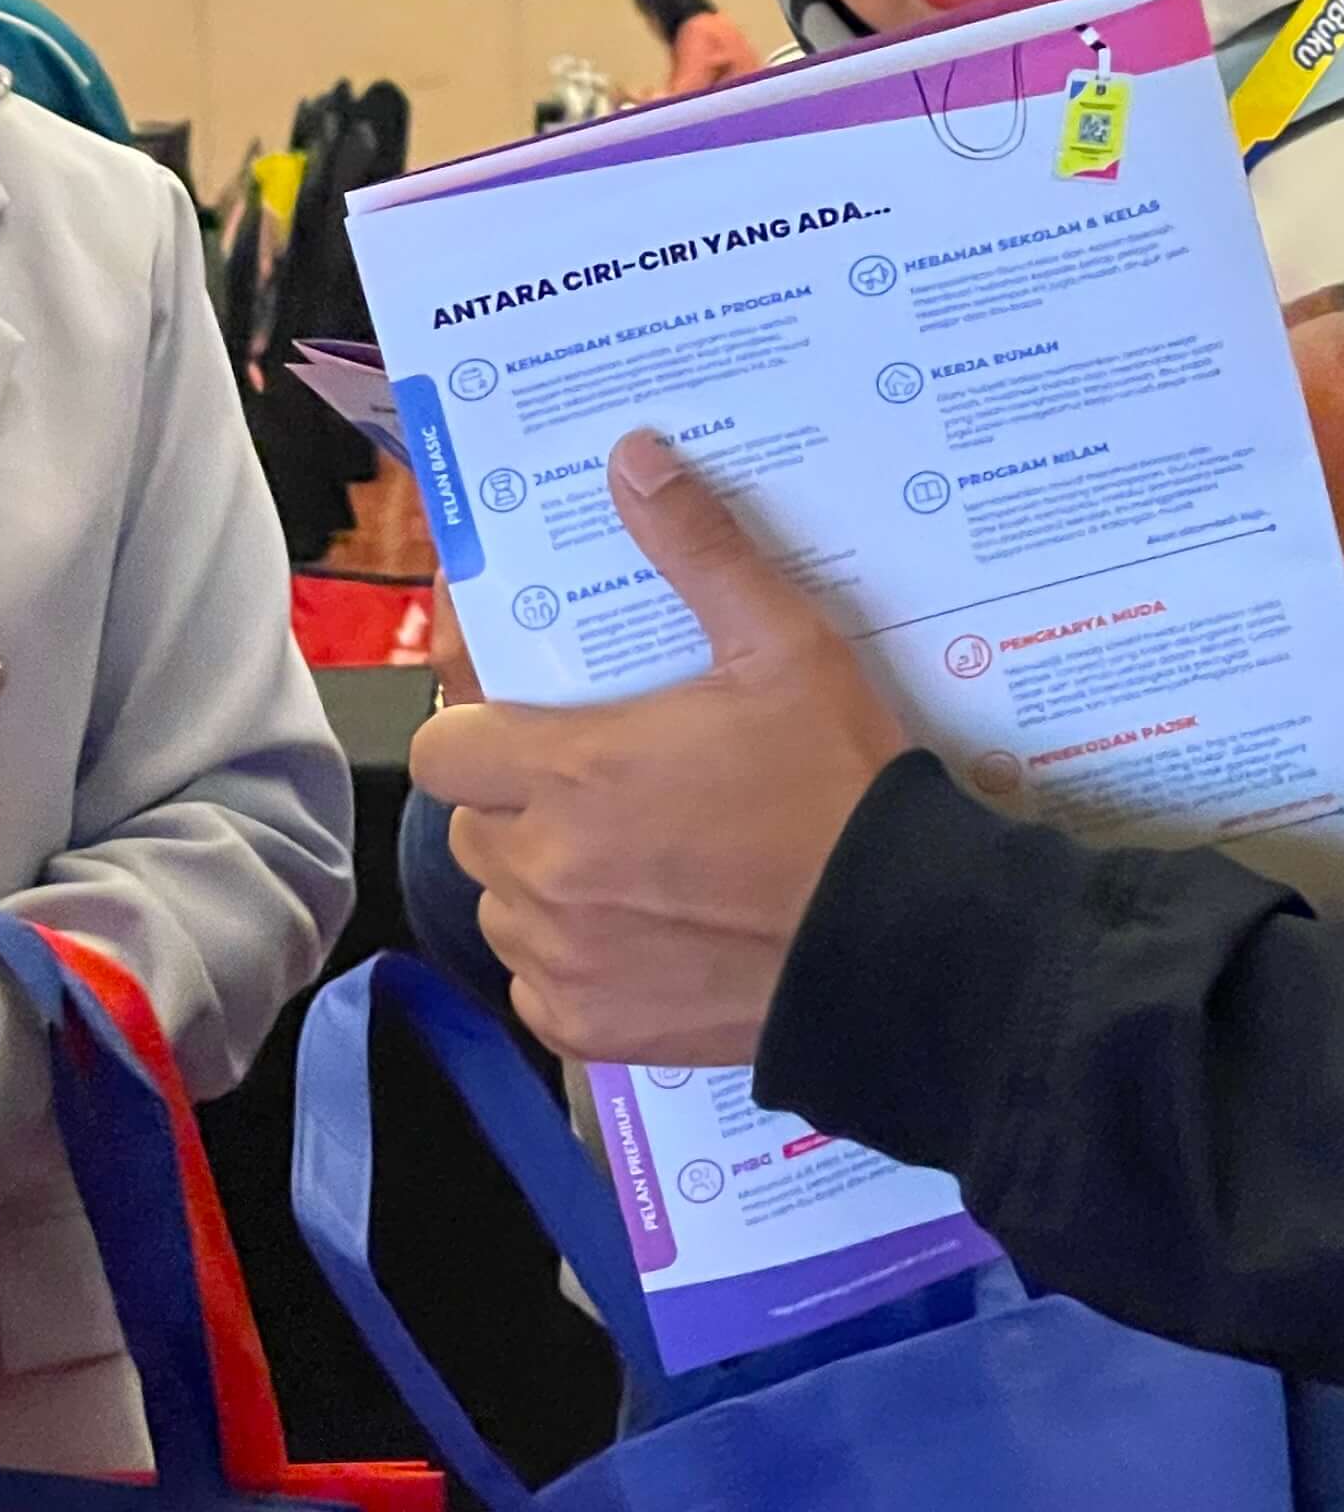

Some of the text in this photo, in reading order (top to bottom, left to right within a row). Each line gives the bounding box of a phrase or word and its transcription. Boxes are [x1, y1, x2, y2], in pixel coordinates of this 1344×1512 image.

[904, 241, 993, 273] HEBAHAN
[997, 220, 1082, 251] SEKOLAH
[1103, 199, 1161, 225] KELAS
[432, 201, 893, 330] ANTARA CIRI-CIRI YANG ADA...
[505, 335, 612, 374] KEHADIRAN
[615, 311, 700, 343] SEKOLAH
[720, 284, 813, 317] PROGRAM
[931, 357, 990, 380] KERJA
[993, 340, 1060, 365] RUMAH
[679, 416, 736, 443] KELAS
[532, 455, 606, 486] JADUAL
[958, 457, 1049, 489] PROGRAM
[566, 575, 630, 602] RAKAN
[1111, 600, 1168, 624] MUDA
[611, 1096, 659, 1233] PELAN PREMIUM
